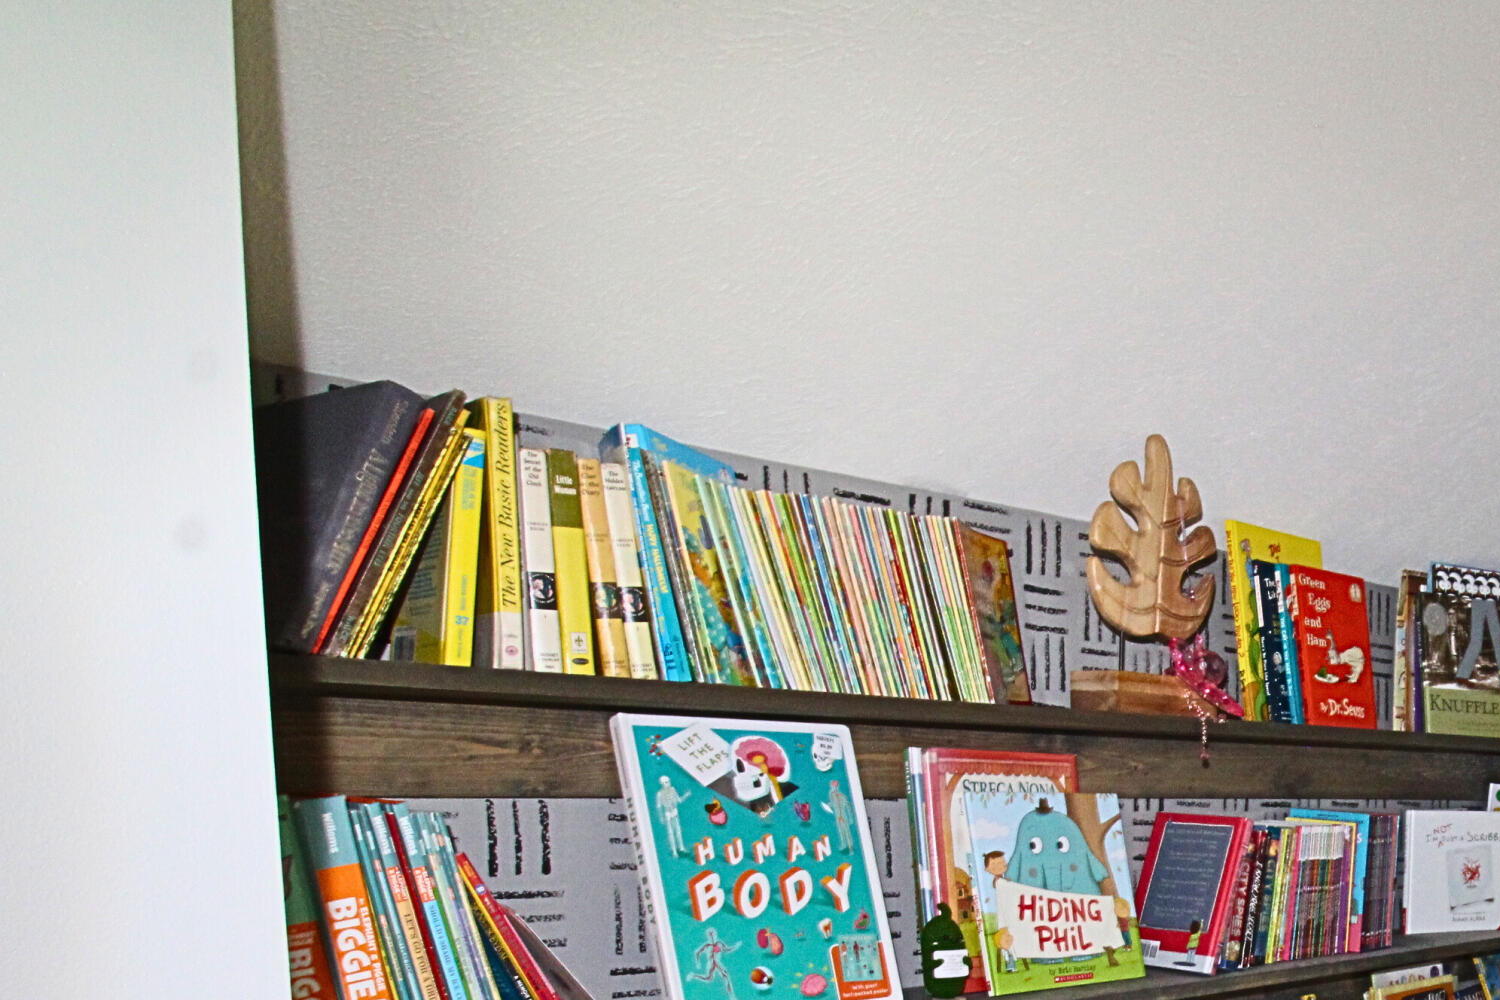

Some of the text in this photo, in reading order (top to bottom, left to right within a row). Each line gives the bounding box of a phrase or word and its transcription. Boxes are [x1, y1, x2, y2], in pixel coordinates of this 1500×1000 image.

[495, 403, 519, 607] The New Basic Readers
[1298, 573, 1326, 590] Green
[1307, 593, 1331, 612] Eggs
[1304, 616, 1322, 628] and
[1306, 634, 1327, 648] Ham
[677, 732, 703, 753] LIFT
[690, 740, 714, 761] THE
[696, 750, 730, 774] FLAPS
[321, 813, 338, 855] Willems
[693, 833, 832, 866] HUMAN
[688, 862, 852, 922] BODY
[515, 978, 531, 1000] MEMOIR
